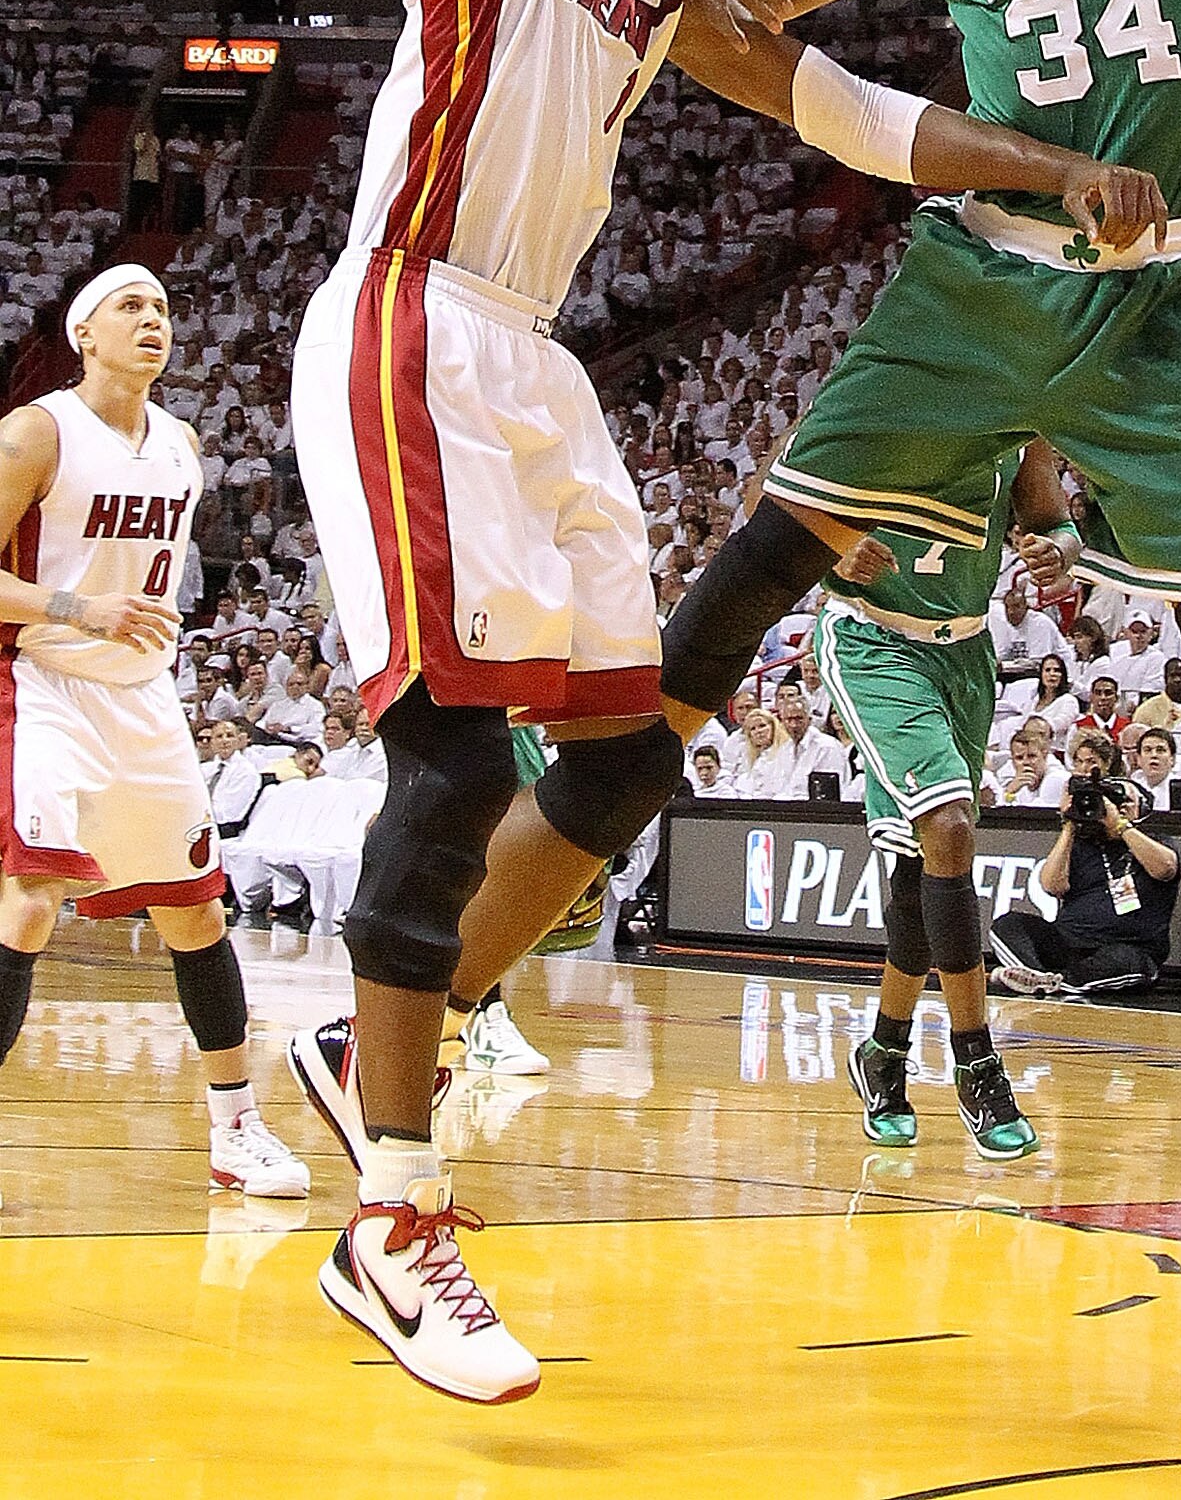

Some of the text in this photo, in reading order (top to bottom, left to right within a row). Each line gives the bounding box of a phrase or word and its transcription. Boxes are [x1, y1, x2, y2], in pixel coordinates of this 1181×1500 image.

[187, 46, 276, 65] BACARDI
[83, 488, 192, 540] HEAT
[143, 549, 171, 598] 0
